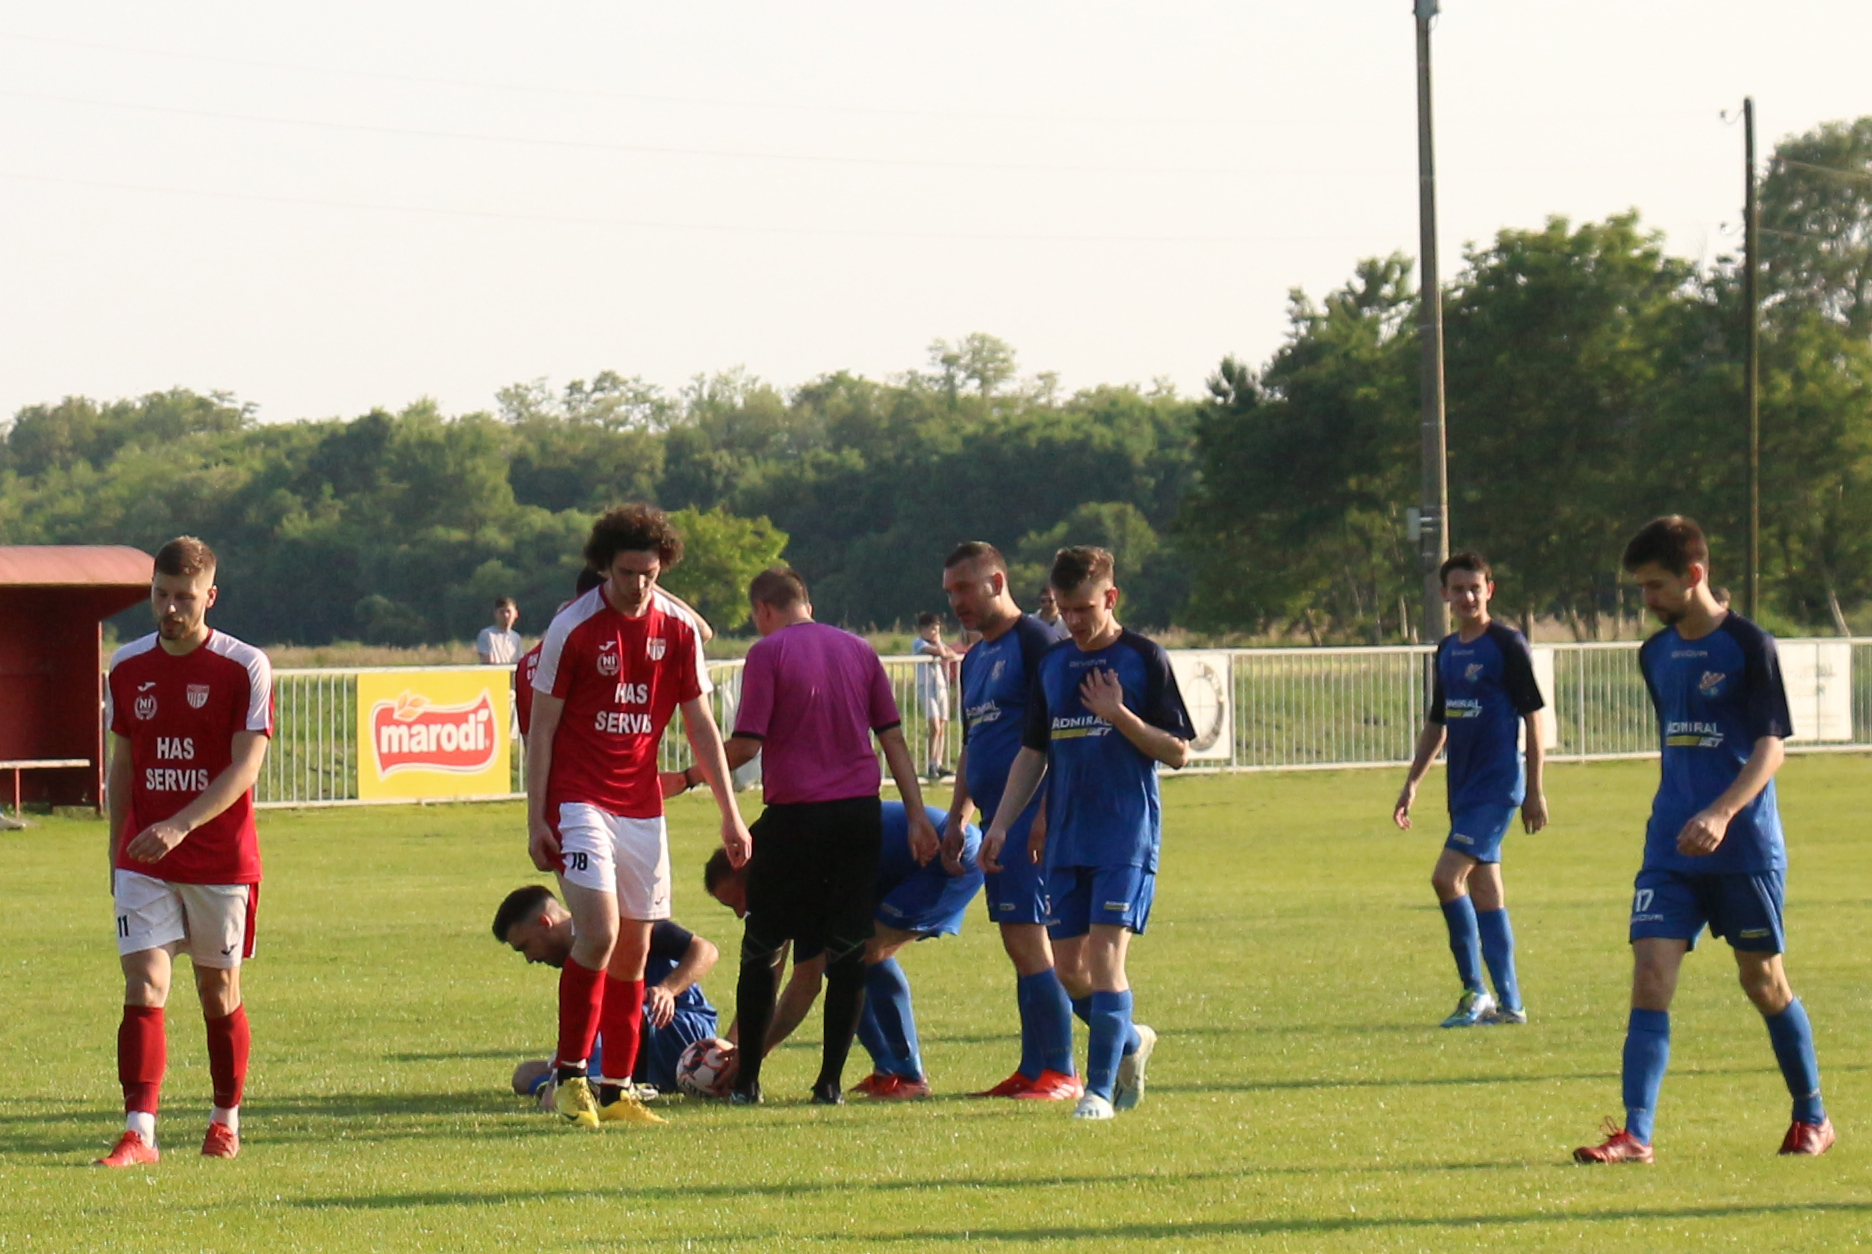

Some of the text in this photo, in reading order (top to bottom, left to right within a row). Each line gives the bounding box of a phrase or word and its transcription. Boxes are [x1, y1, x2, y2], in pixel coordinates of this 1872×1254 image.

[615, 683, 648, 704] HAS
[381, 709, 489, 753] marodi
[156, 737, 195, 760] HAS
[146, 768, 208, 791] SERVIS
[571, 852, 588, 871] 18
[1635, 888, 1655, 913] 17
[117, 915, 129, 938] 11
